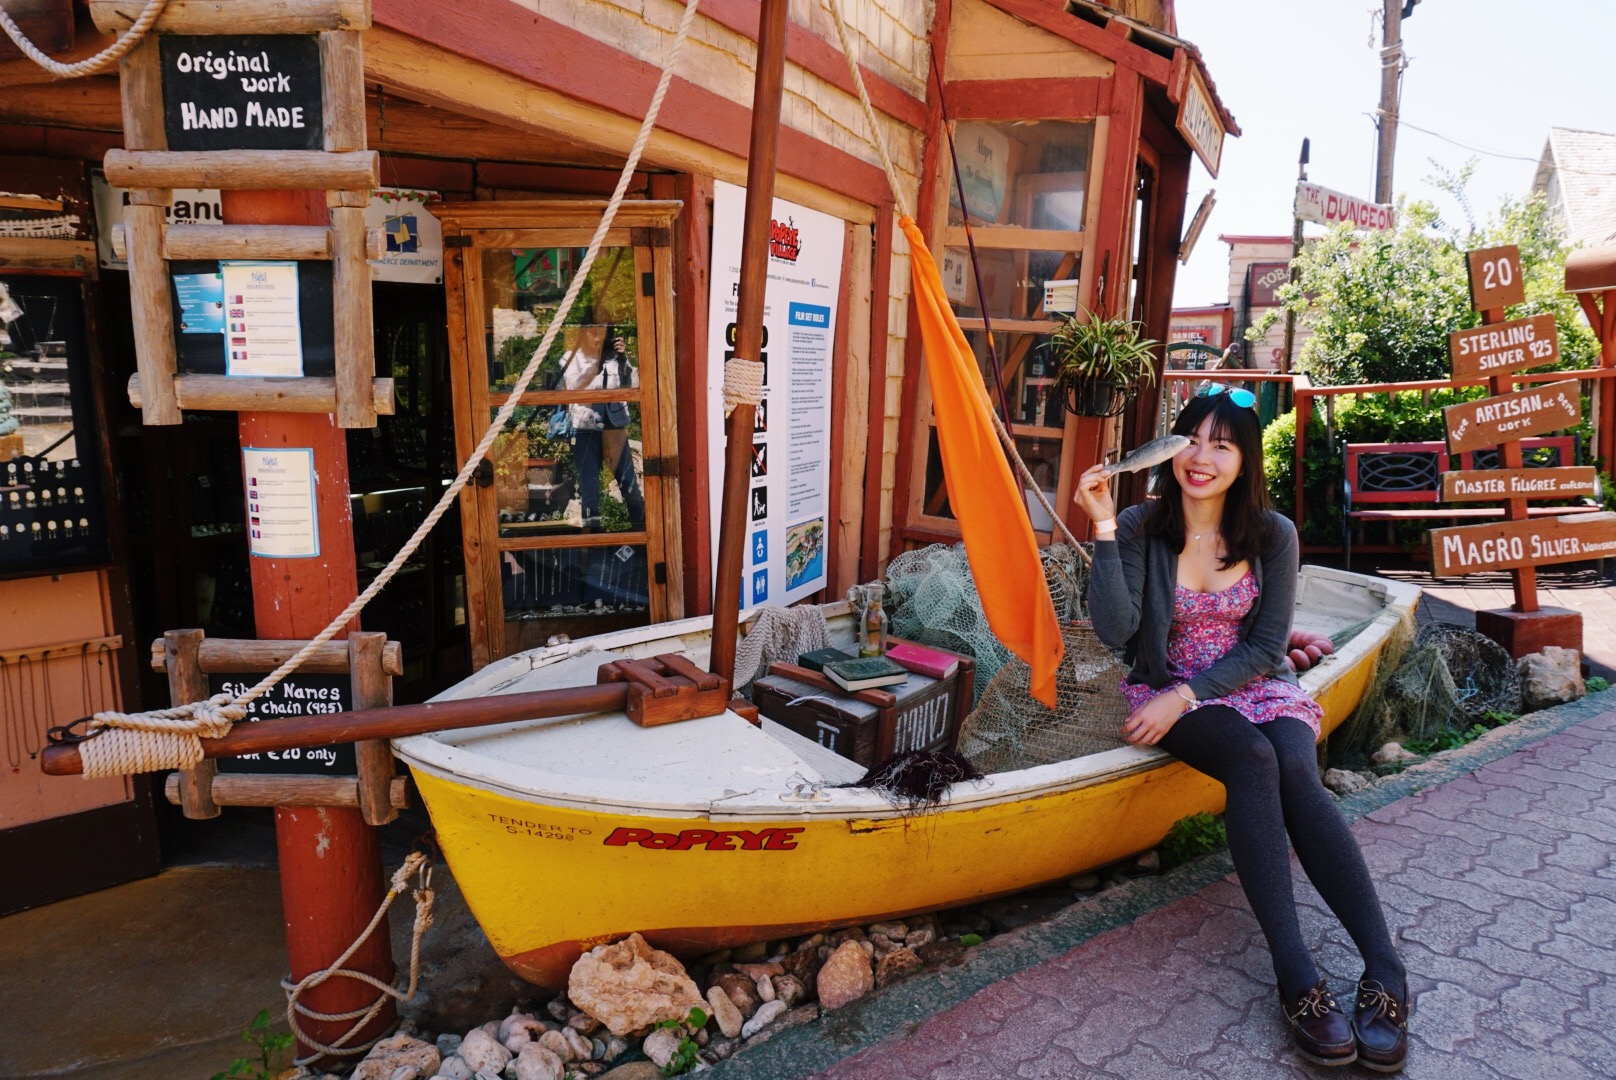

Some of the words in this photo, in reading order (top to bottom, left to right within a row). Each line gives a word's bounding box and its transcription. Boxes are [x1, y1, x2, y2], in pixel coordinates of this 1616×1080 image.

[177, 51, 270, 79] Original
[240, 72, 290, 93] work
[180, 102, 238, 130] HAND
[245, 102, 305, 129] MADE
[1305, 187, 1320, 205] THE
[1326, 194, 1393, 230] DUNGEON
[770, 219, 798, 248] POPEYE
[399, 258, 439, 266] DEPARTMENT
[769, 241, 798, 262] VILLAGE
[1483, 257, 1512, 289] 20
[1459, 324, 1535, 355] STERLING
[1479, 349, 1525, 370] SILVER
[1529, 339, 1552, 359] 925
[1475, 394, 1543, 424] ARTISAN
[1454, 479, 1506, 495] MASTER
[1511, 477, 1557, 492] FILIGREE
[1443, 535, 1524, 568] MAGRO
[1531, 535, 1580, 559] SILVER
[283, 682, 341, 701] Names
[261, 701, 302, 714] chain
[306, 748, 337, 766] only
[487, 813, 562, 832] TENDER
[568, 827, 592, 835] TO
[506, 825, 574, 841] S-14298
[603, 826, 806, 851] POPEYE
